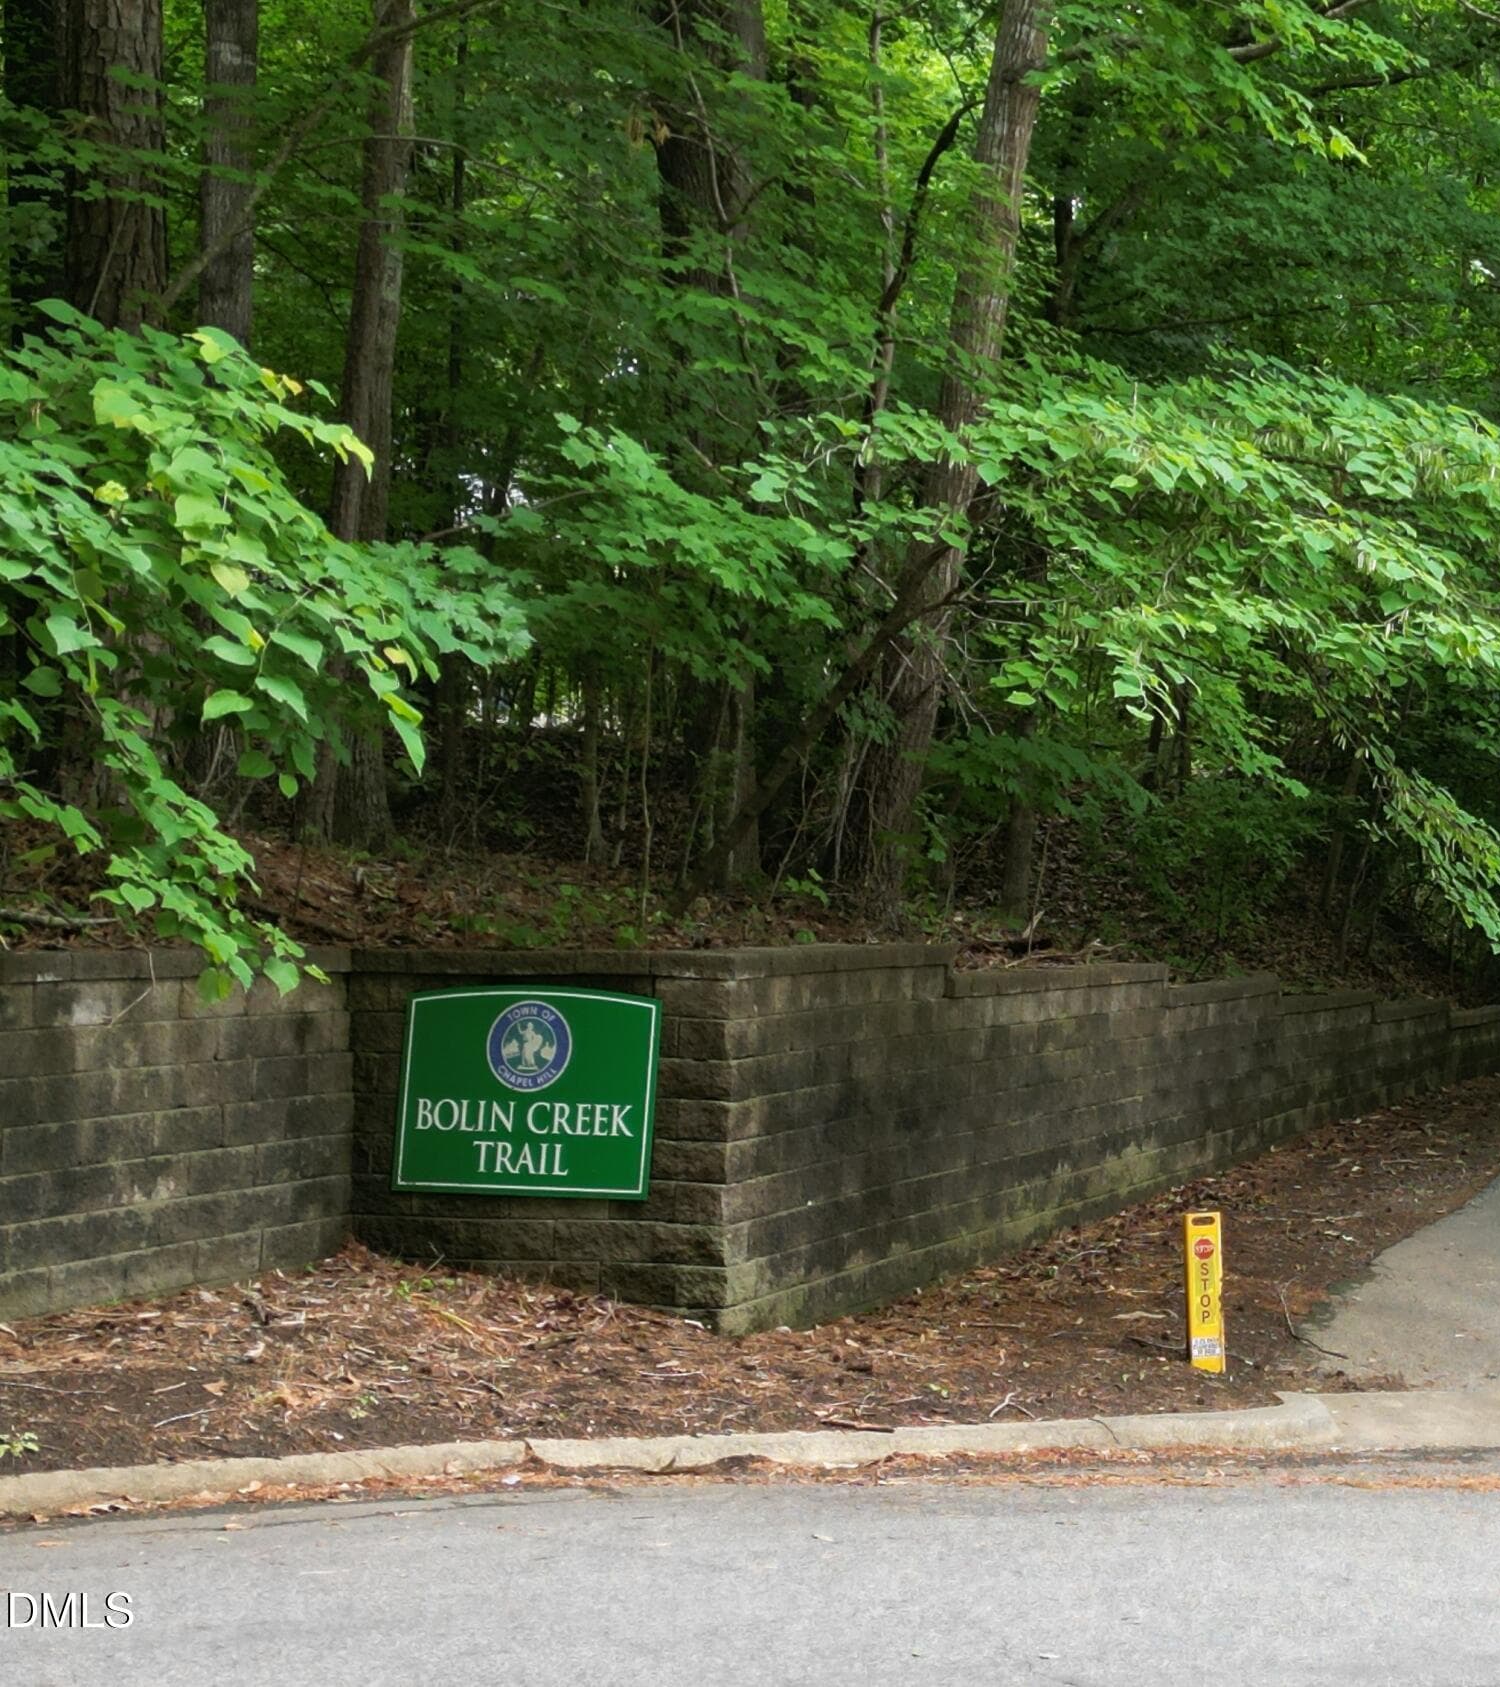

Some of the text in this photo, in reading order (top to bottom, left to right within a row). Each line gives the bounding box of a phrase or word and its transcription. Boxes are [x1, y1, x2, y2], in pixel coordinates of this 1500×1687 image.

[506, 1006, 557, 1022] TOWN OF
[498, 1065, 557, 1087] CHAPEL HILL
[415, 1098, 633, 1137] BOLIN CREEK
[473, 1141, 569, 1176] TRAIL
[1200, 1262, 1211, 1323] STOP
